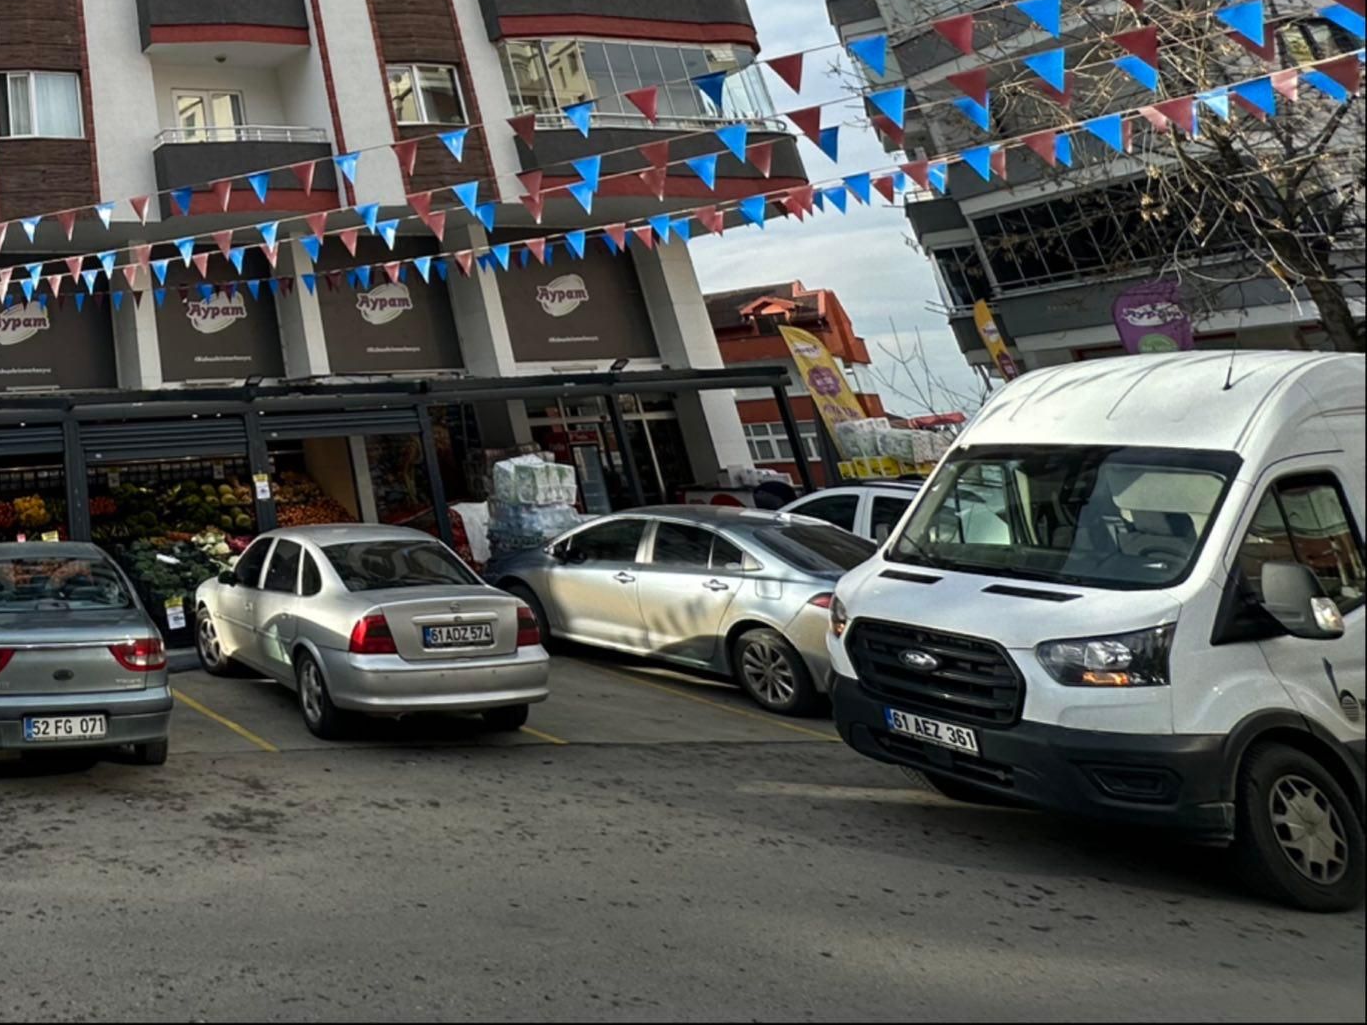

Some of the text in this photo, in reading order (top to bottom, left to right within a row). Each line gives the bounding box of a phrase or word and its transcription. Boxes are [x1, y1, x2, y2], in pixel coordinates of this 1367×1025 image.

[358, 293, 412, 310] Aypam
[537, 284, 588, 301] Aypam
[189, 301, 245, 319] Aypam
[33, 717, 104, 735] 52 FG 071
[893, 711, 975, 748] 61 AEZ 361
